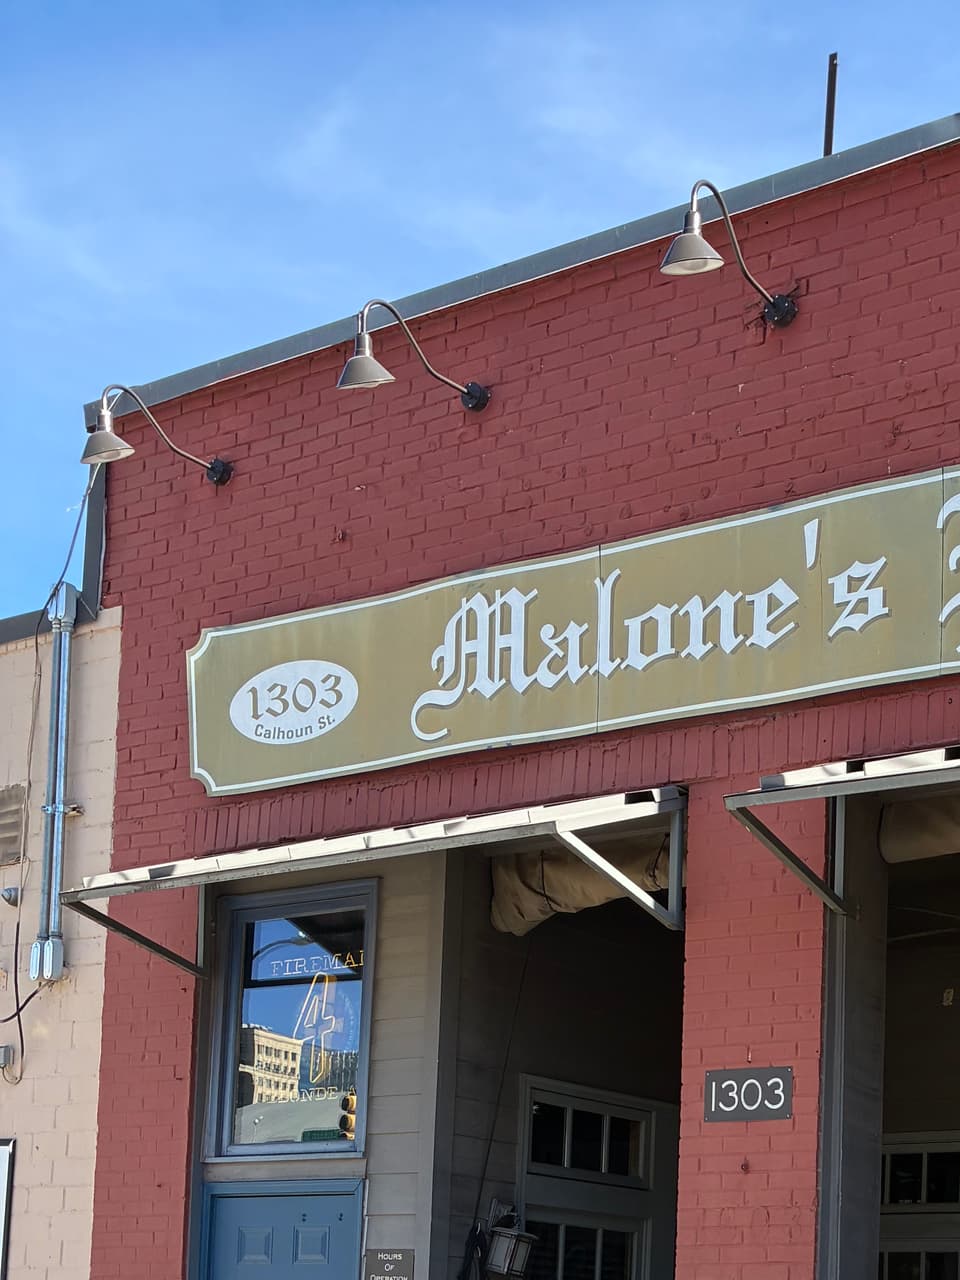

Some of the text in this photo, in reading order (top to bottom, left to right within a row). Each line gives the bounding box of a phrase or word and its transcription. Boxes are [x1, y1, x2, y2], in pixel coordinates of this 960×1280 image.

[410, 518, 890, 741] Malone's
[247, 673, 344, 721] 1303
[254, 715, 336, 741] Calhoun St.
[293, 971, 336, 1084] 4
[711, 1077, 785, 1112] 1303
